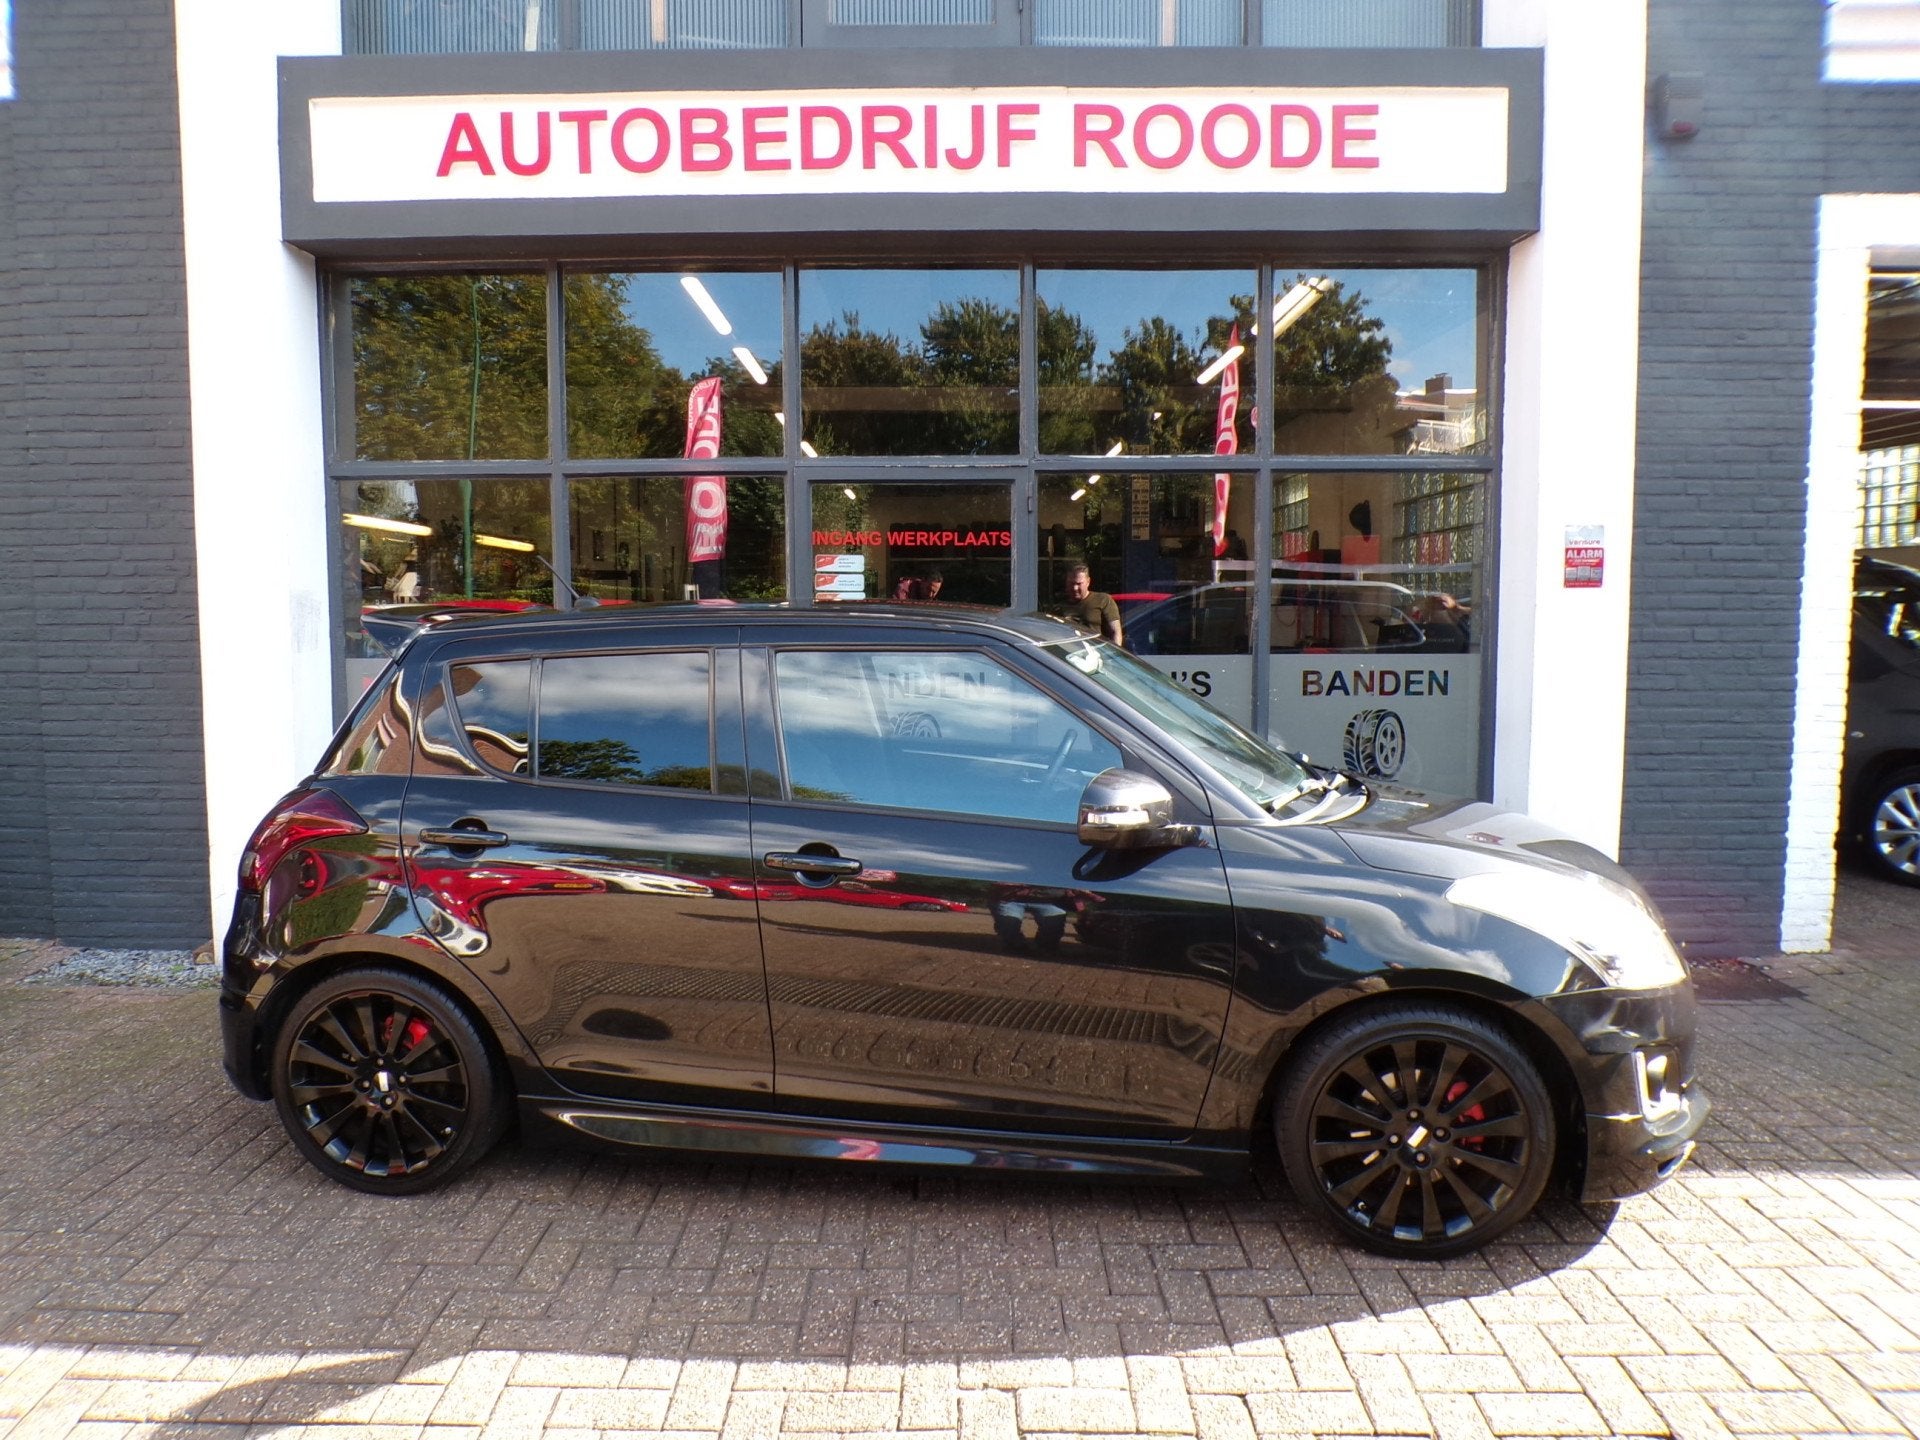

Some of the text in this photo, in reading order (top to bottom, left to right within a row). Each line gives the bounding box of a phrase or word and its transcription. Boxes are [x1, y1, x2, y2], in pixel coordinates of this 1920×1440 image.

[436, 103, 1380, 177] AUTOBEDRIJF ROODE
[812, 531, 1012, 546] INGANG WERKPLAATS
[1567, 549, 1603, 559] ALARM
[1302, 669, 1449, 697] BANDEN
